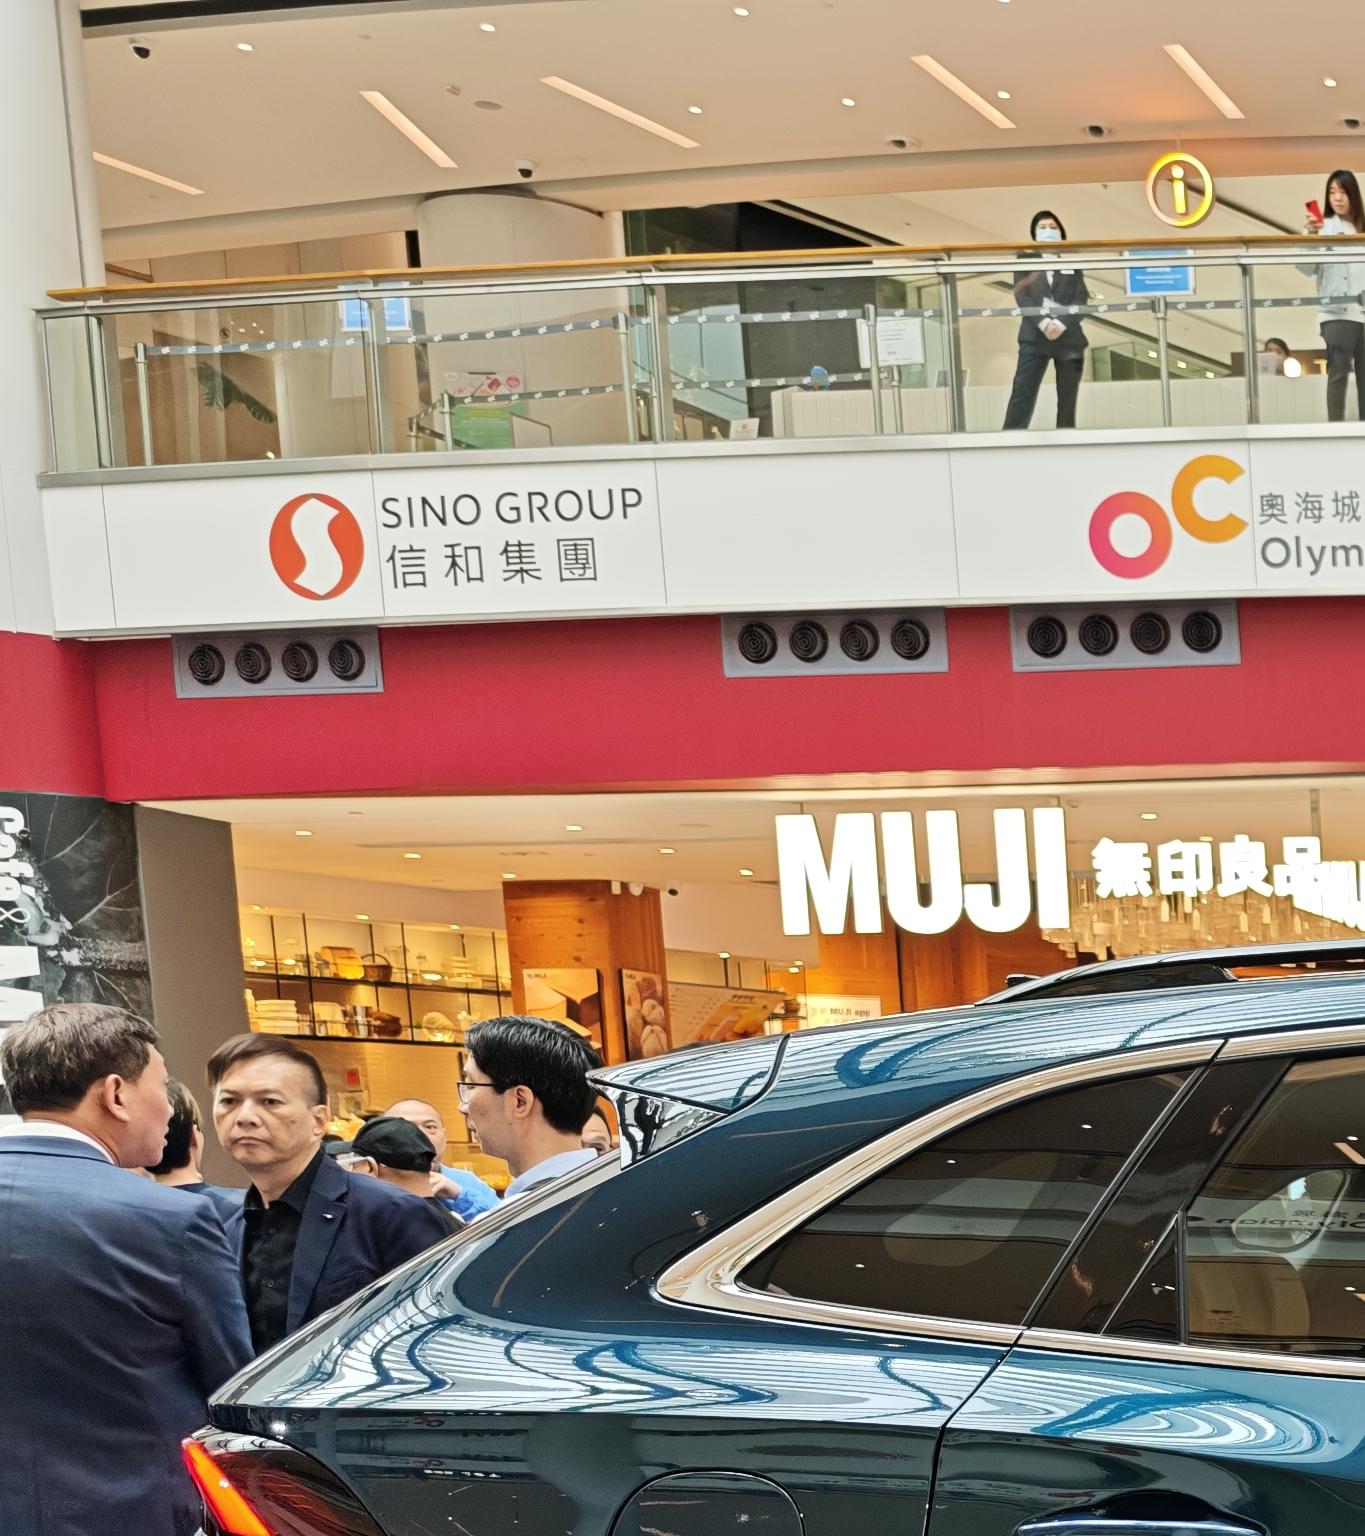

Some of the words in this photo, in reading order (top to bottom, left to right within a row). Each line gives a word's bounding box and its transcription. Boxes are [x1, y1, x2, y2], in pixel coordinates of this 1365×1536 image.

[381, 493, 482, 529] SINO
[495, 487, 643, 525] GROUP
[1088, 454, 1249, 580] OC
[1258, 491, 1362, 525] 奧海城
[385, 537, 598, 590] 信和集團
[775, 807, 1070, 936] MUJI
[1091, 834, 1321, 898] 無印良品
